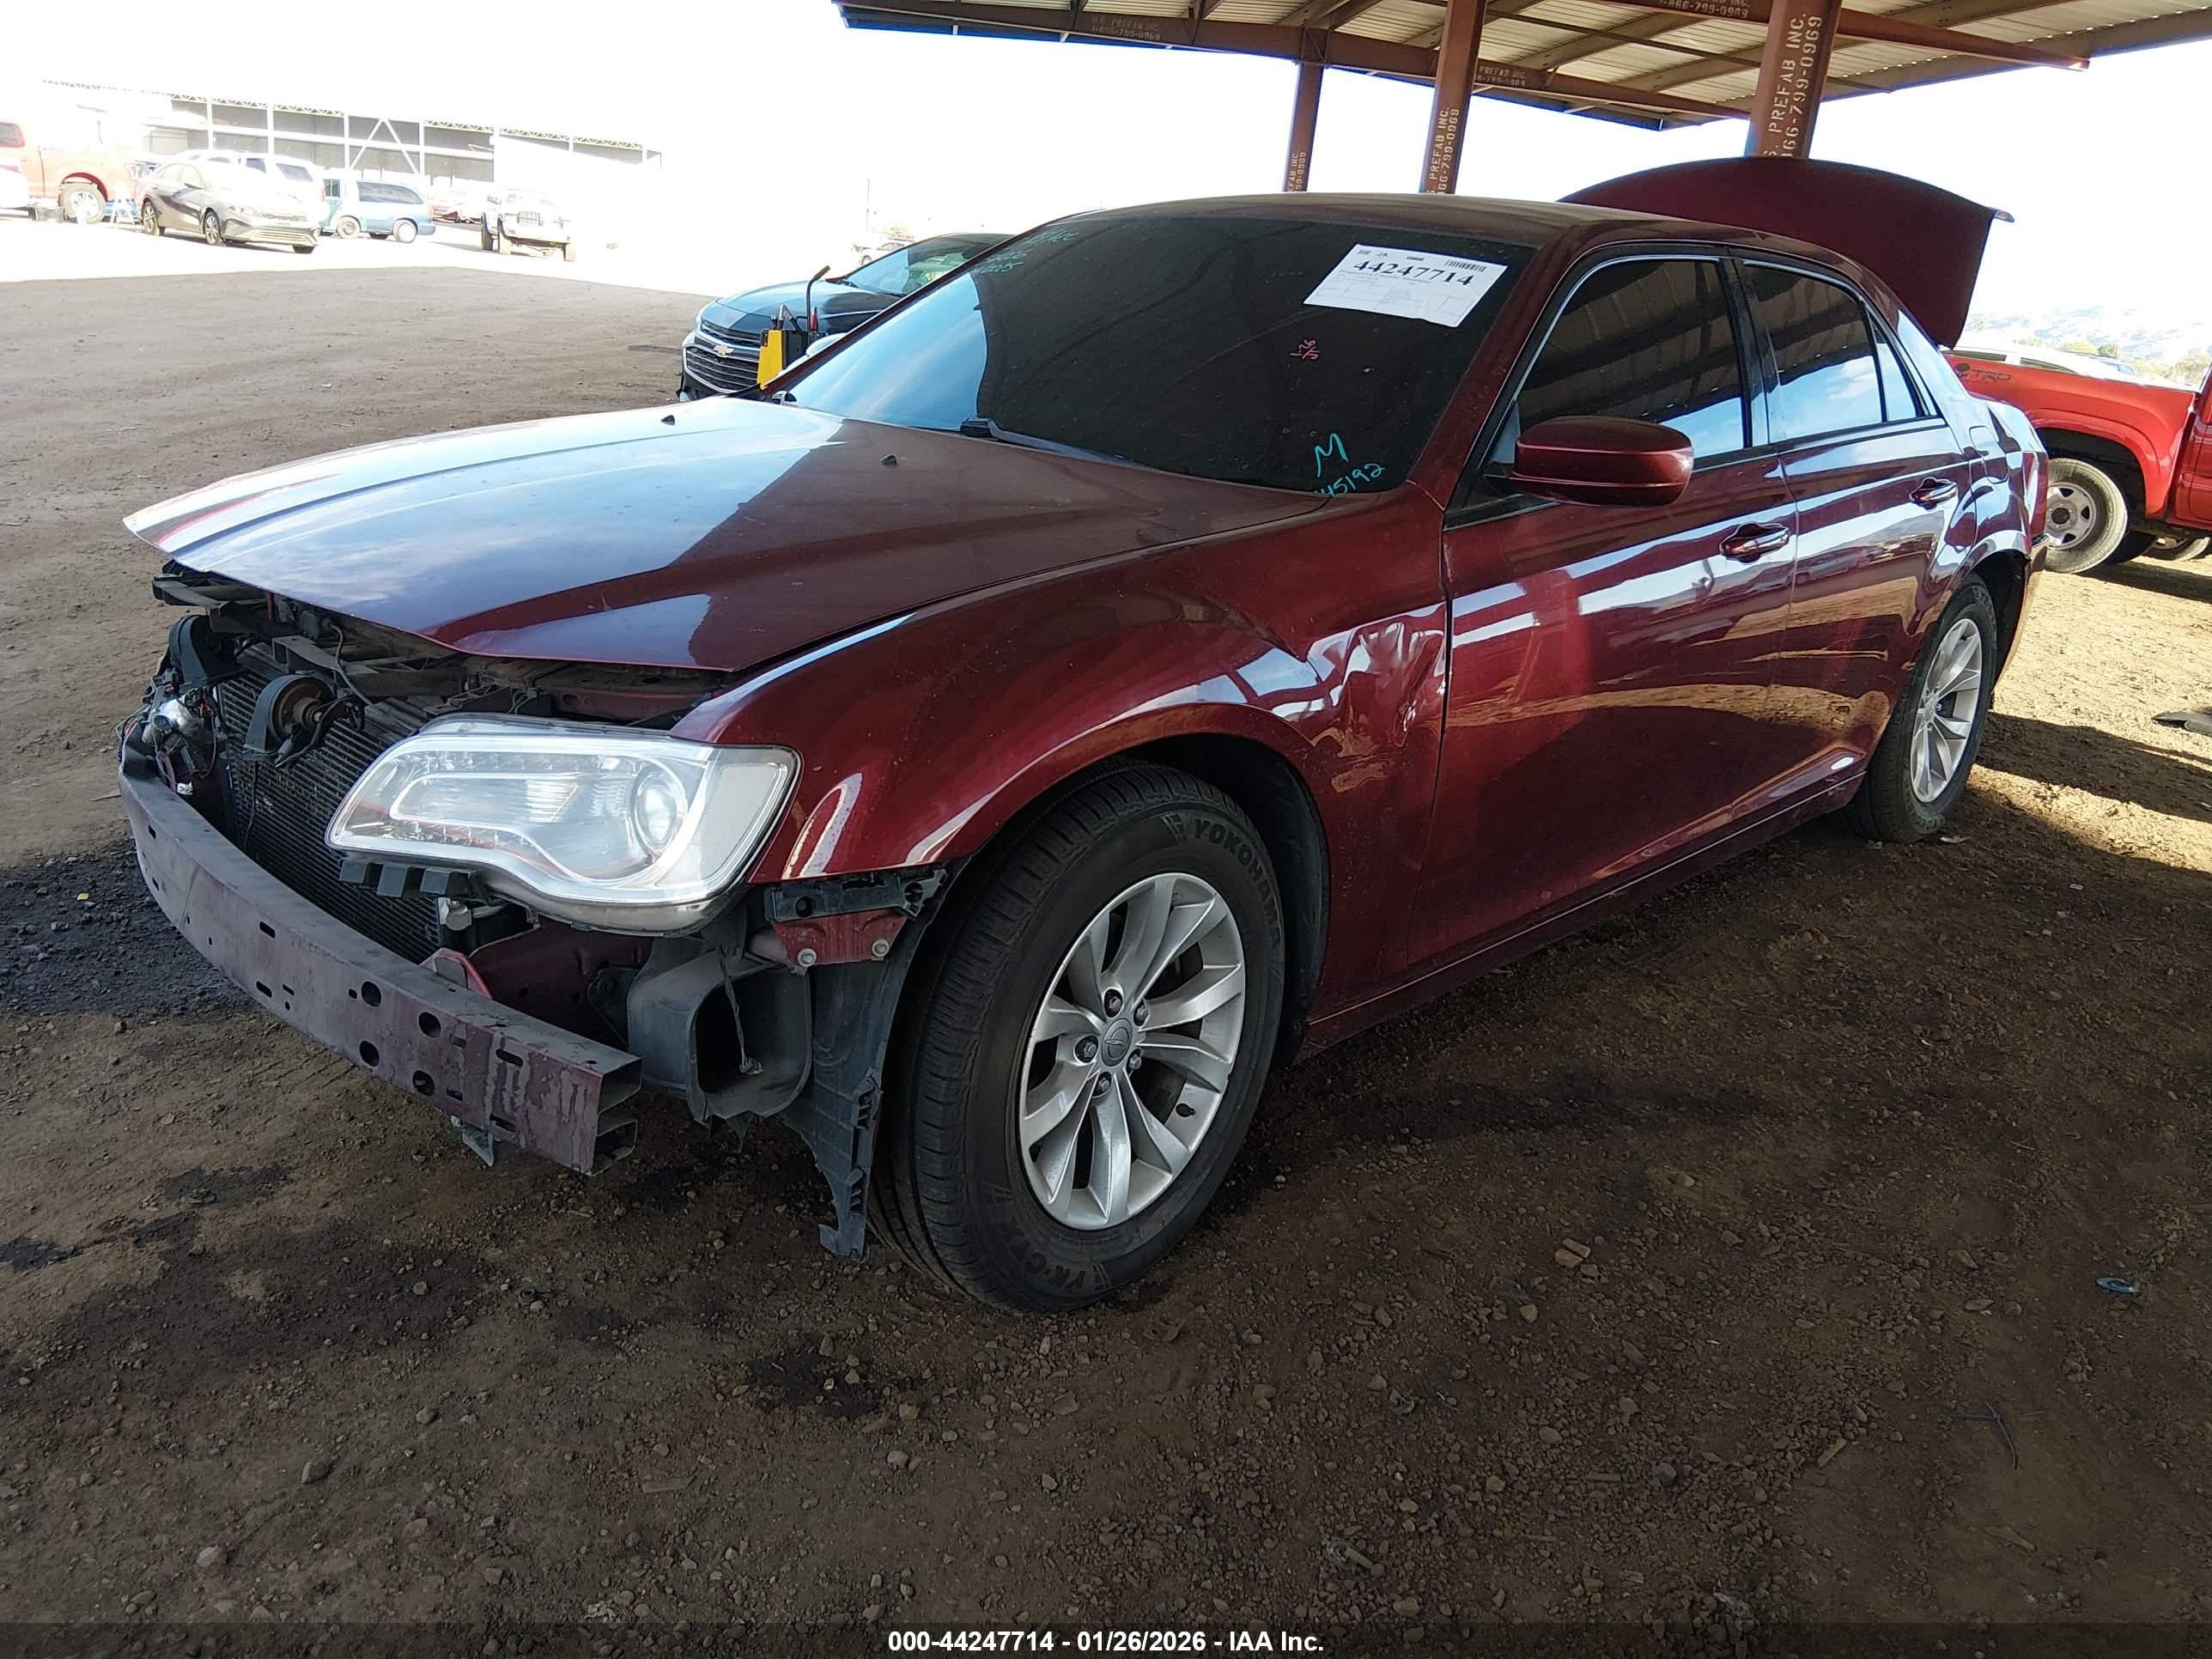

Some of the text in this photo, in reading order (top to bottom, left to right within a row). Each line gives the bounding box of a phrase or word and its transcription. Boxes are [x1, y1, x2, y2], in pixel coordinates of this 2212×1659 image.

[1767, 59, 1796, 133] PREFAB
[1785, 13, 1807, 49] INC.
[1429, 134, 1444, 179] PREFAB
[1437, 106, 1450, 129] INC.
[1294, 152, 1307, 192] 99-0969
[1353, 260, 1475, 286] 44247714
[1971, 369, 2012, 382] TRD
[1314, 433, 1349, 477] M
[1313, 463, 1386, 497] 45192
[1194, 818, 1282, 950] YOKOHAMA
